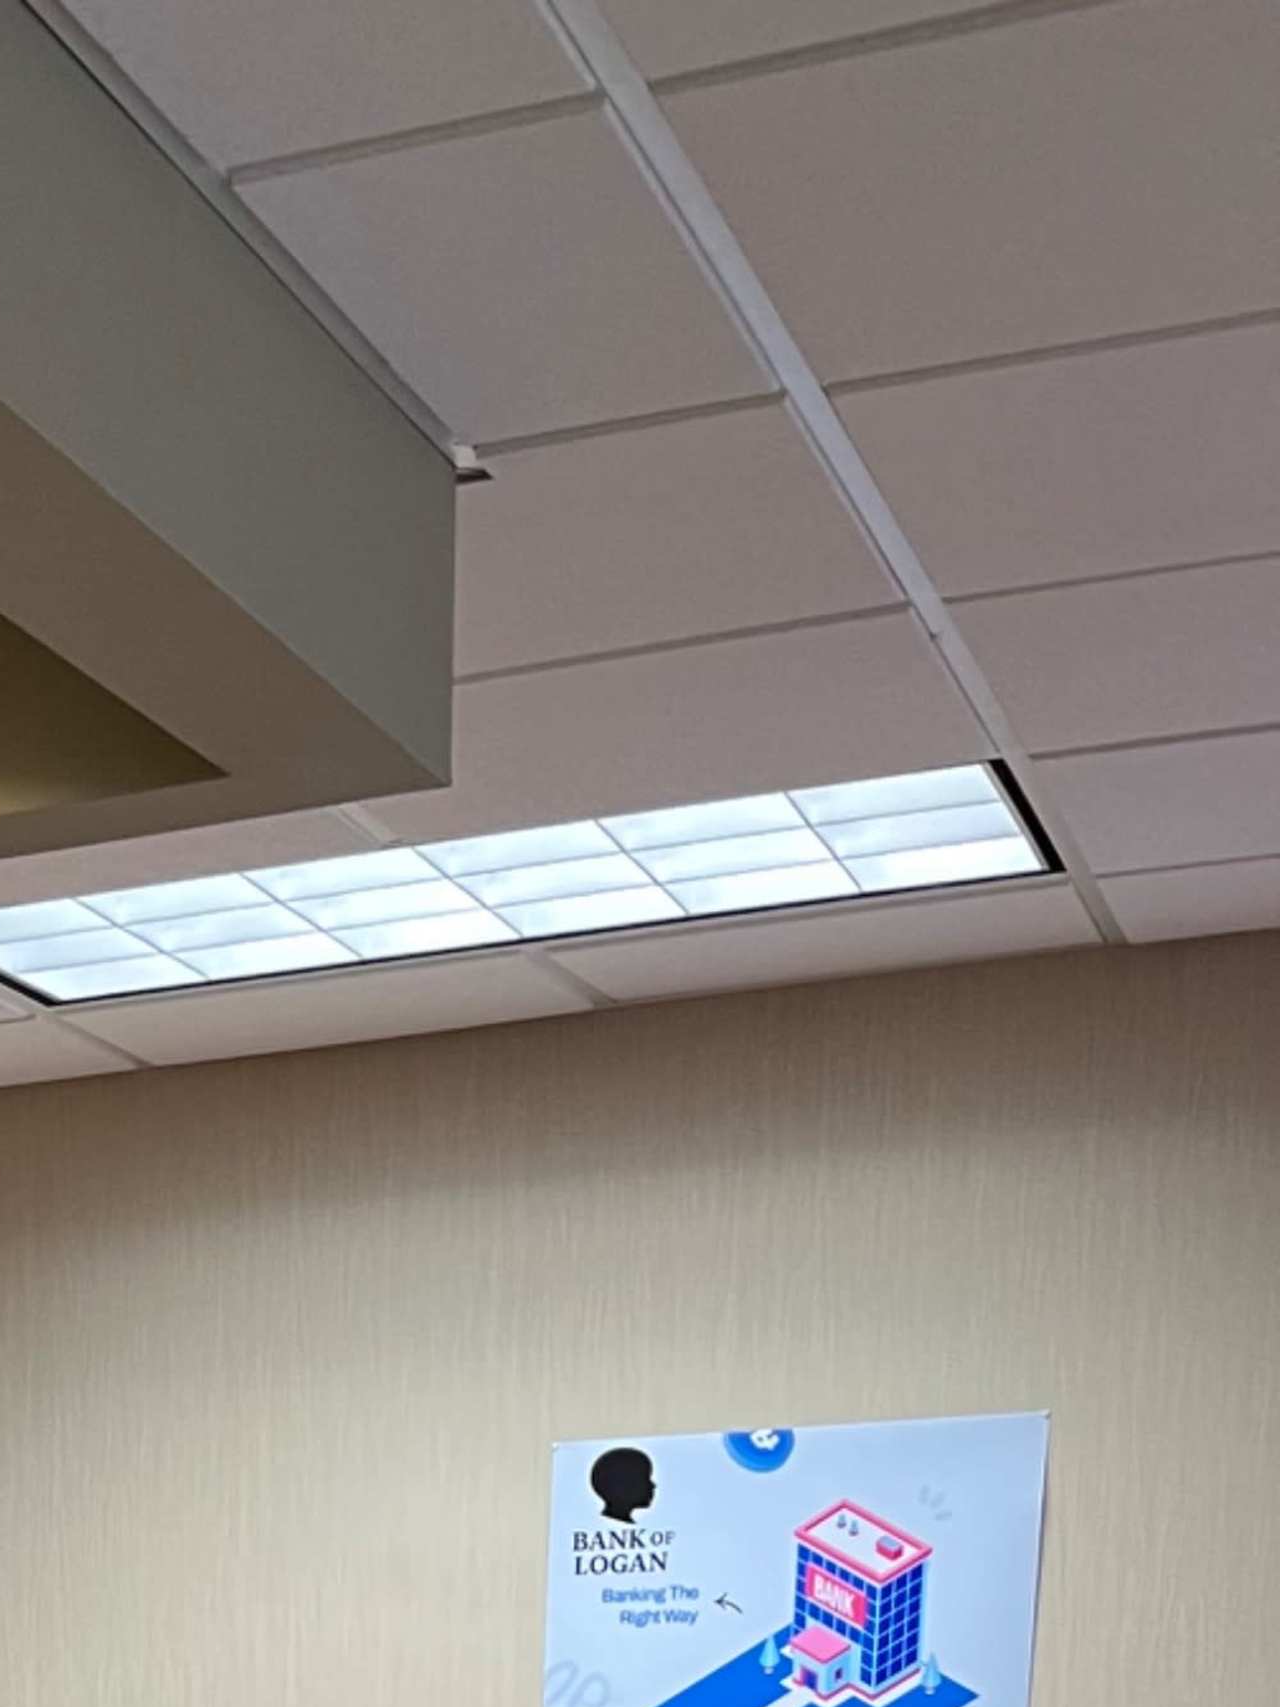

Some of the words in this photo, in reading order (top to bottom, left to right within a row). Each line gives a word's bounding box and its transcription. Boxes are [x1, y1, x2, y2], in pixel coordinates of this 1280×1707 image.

[573, 1529, 646, 1552] BANK
[649, 1530, 676, 1546] OF
[575, 1551, 669, 1576] LOGAN
[601, 1586, 667, 1605] Banking
[669, 1584, 700, 1601] The
[813, 1573, 855, 1620] BANK
[619, 1608, 662, 1629] Right
[663, 1608, 699, 1627] Way
